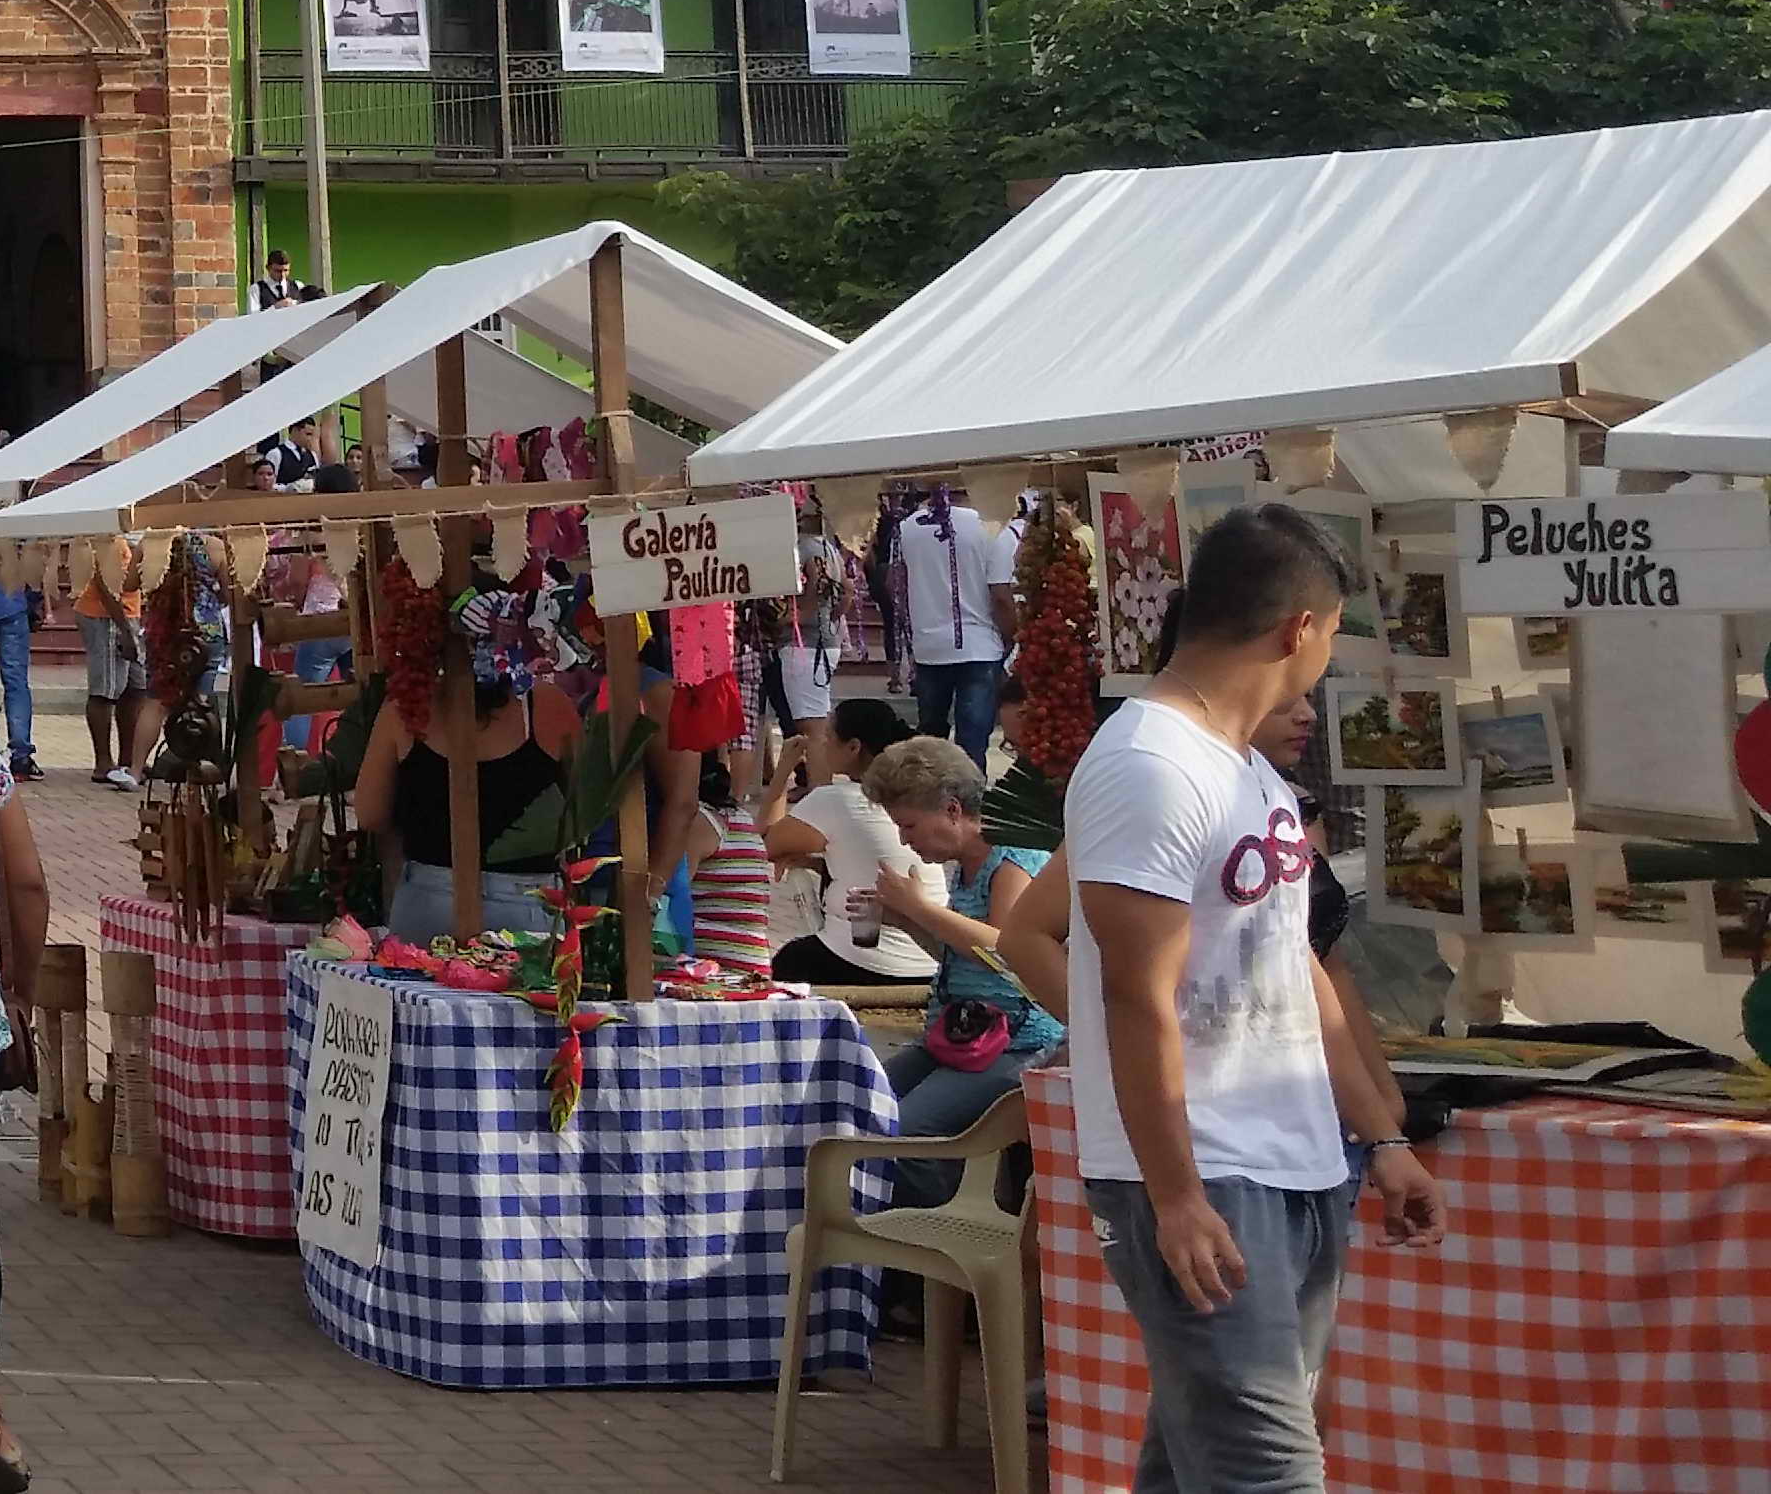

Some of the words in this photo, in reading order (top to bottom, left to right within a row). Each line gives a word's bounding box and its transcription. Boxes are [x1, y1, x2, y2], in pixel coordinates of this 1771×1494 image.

[622, 512, 718, 558] Galería
[1477, 502, 1652, 564] Peluches
[663, 556, 751, 602] Paulina
[1563, 555, 1680, 608] Yulita
